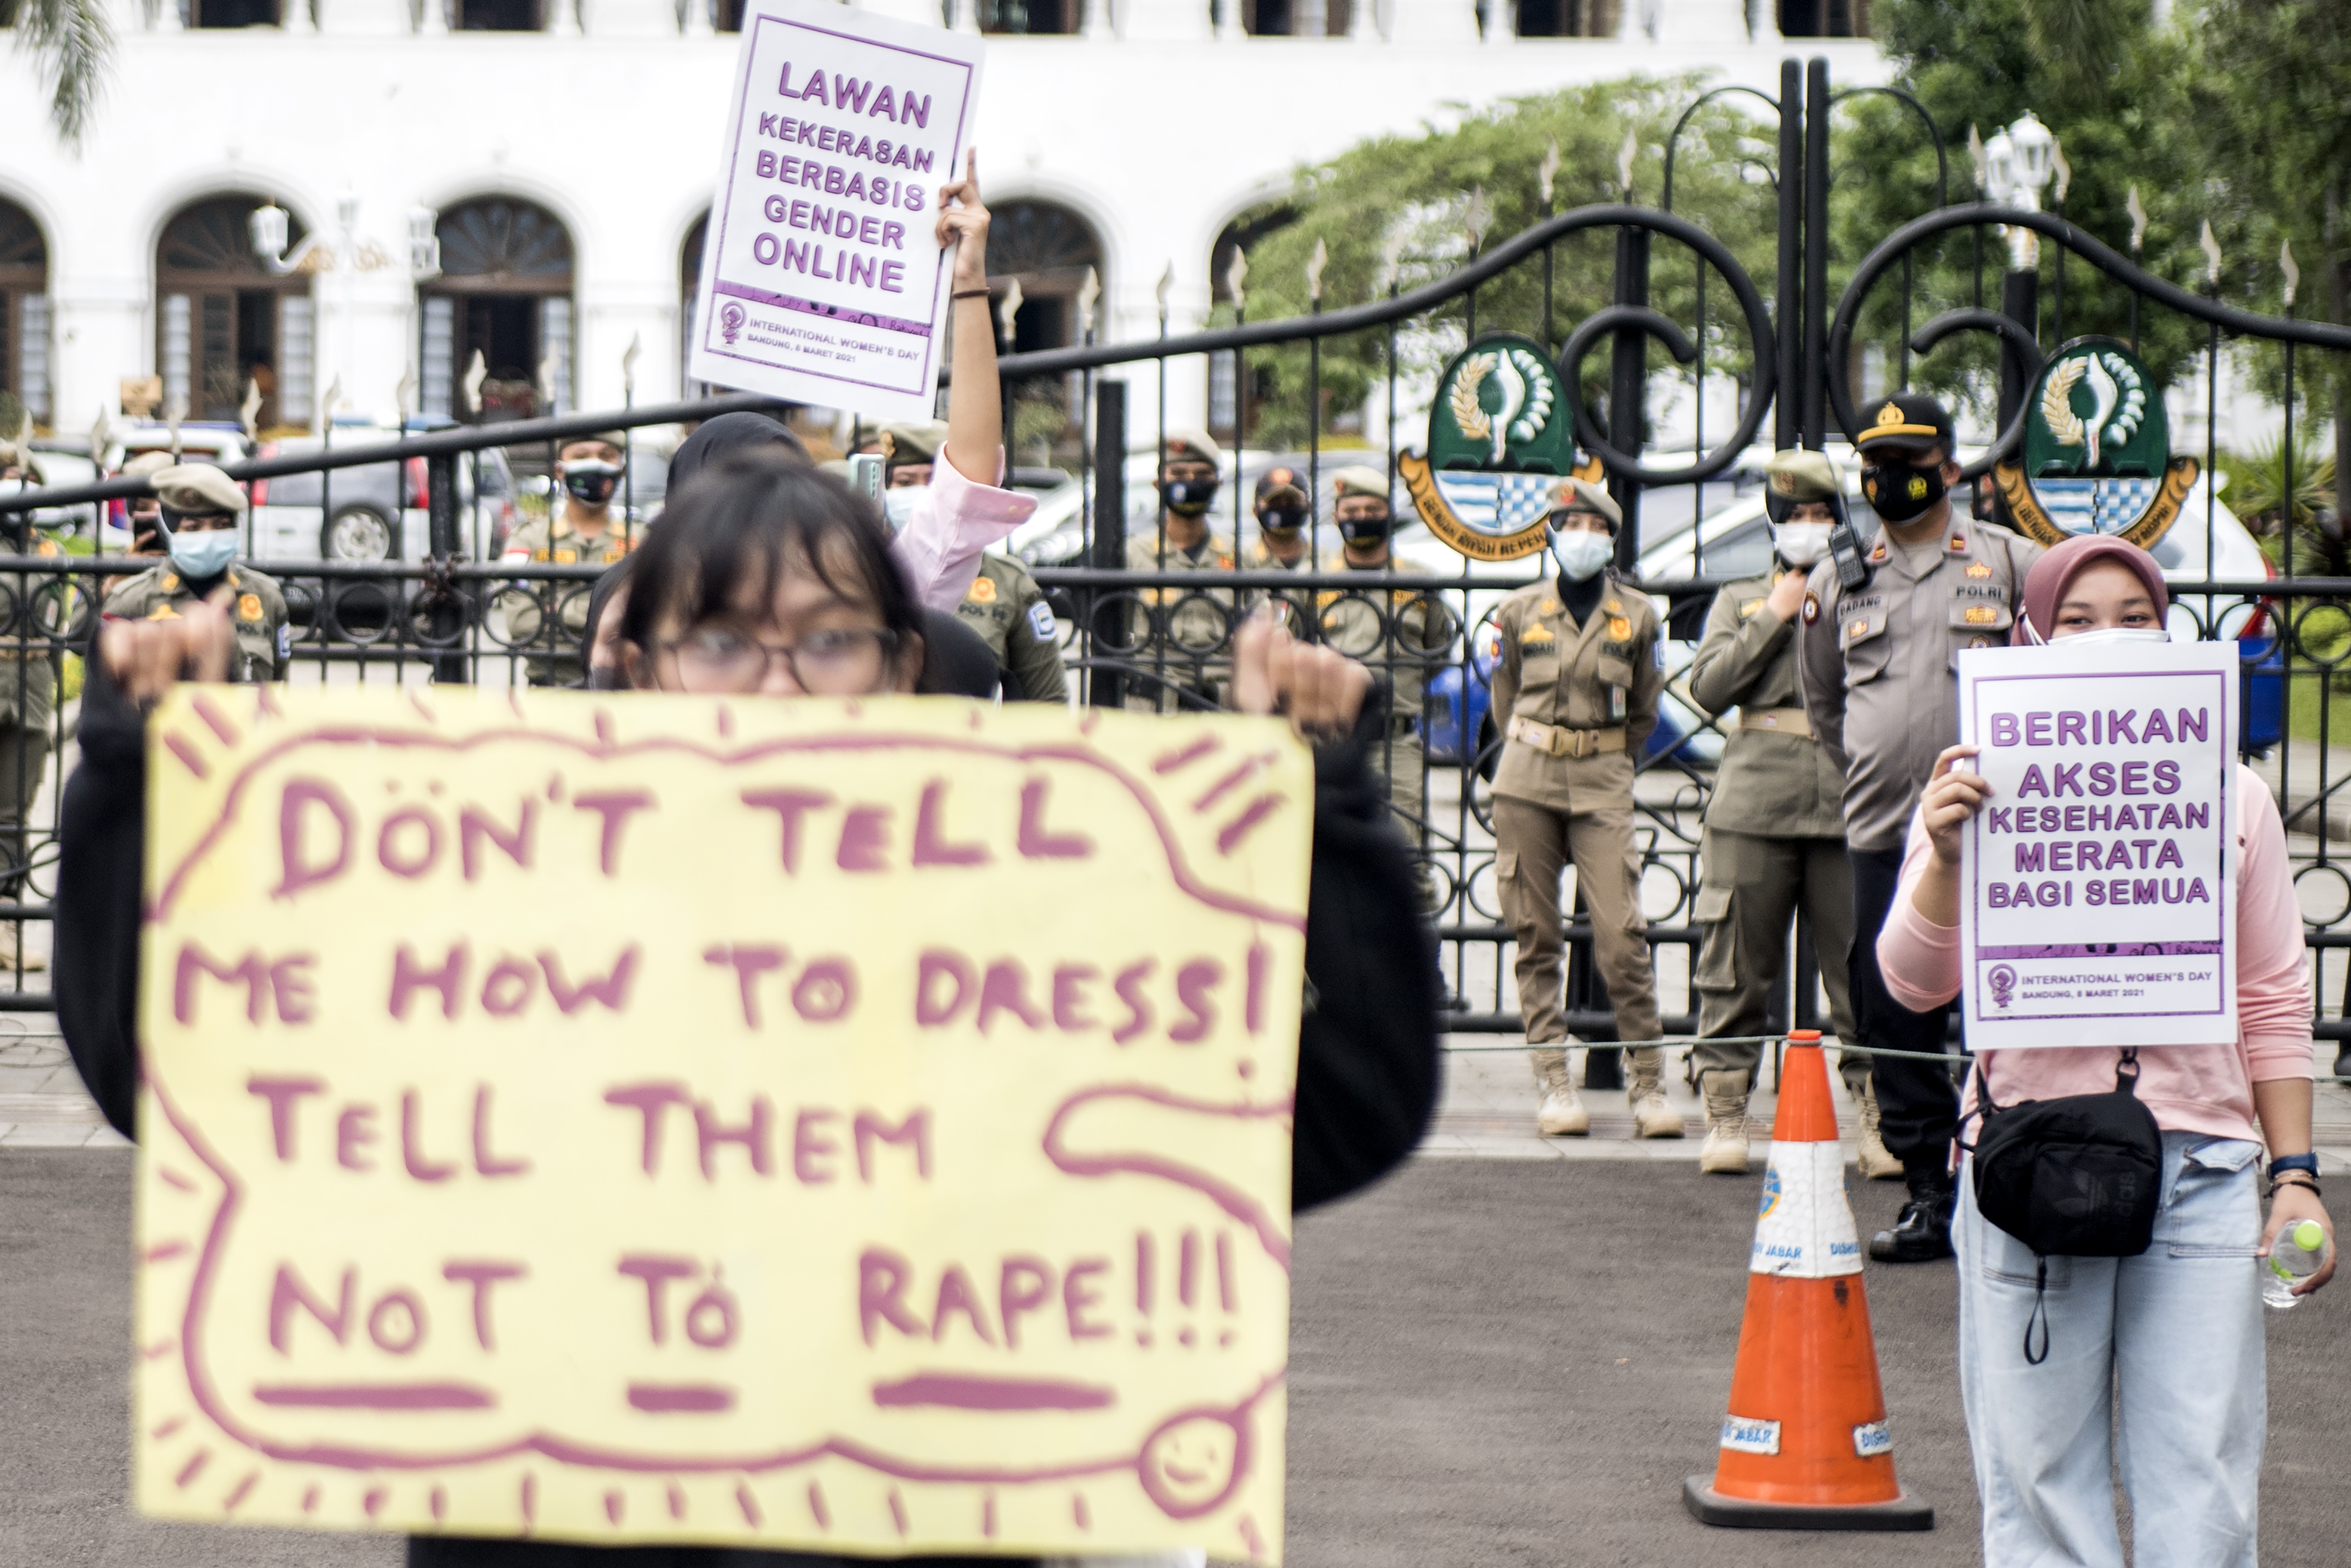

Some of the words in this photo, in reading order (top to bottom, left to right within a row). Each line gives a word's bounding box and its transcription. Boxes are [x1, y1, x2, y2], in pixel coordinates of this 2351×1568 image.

[777, 61, 932, 129] LAWAN
[758, 112, 934, 173] KEKERASAN
[756, 149, 925, 212] BERBASIS
[764, 195, 905, 250] GENDER
[753, 232, 906, 294] ONLINE
[748, 333, 793, 351] BANDUNG,
[803, 344, 833, 358] MARET
[836, 352, 856, 363] 2021
[749, 318, 837, 346] INTERNATIONAL
[840, 337, 894, 356] WOMEN'S
[898, 349, 920, 361] DAY
[1840, 596, 1881, 617] DADANG
[1957, 585, 2002, 599] POLRI
[1991, 707, 2208, 748] BERIKAN
[2017, 760, 2182, 799] AKSES
[737, 772, 1098, 878] TELL
[1989, 802, 2209, 833] KESEHATAN
[2015, 839, 2183, 873] MERATA
[1988, 881, 2073, 908] BAGI
[2085, 877, 2210, 906] SEMUA
[2021, 973, 2122, 986] INTERNATIONAL
[2125, 972, 2185, 983] WOMEN'S
[2189, 971, 2212, 981] DAY
[2022, 990, 2075, 1000] BANDUNG,
[2085, 989, 2120, 998] MARET
[2122, 989, 2145, 997] 2021
[169, 938, 320, 1030] ME
[384, 937, 642, 1024] HOW
[700, 942, 860, 1032] TO
[910, 937, 1271, 1084] DRESS!
[243, 1070, 533, 1187] TELL
[600, 1078, 933, 1188] THEM
[1766, 1243, 1802, 1259] JABAR
[265, 1257, 530, 1359] NOT
[854, 1225, 1240, 1353] RAPE!!!
